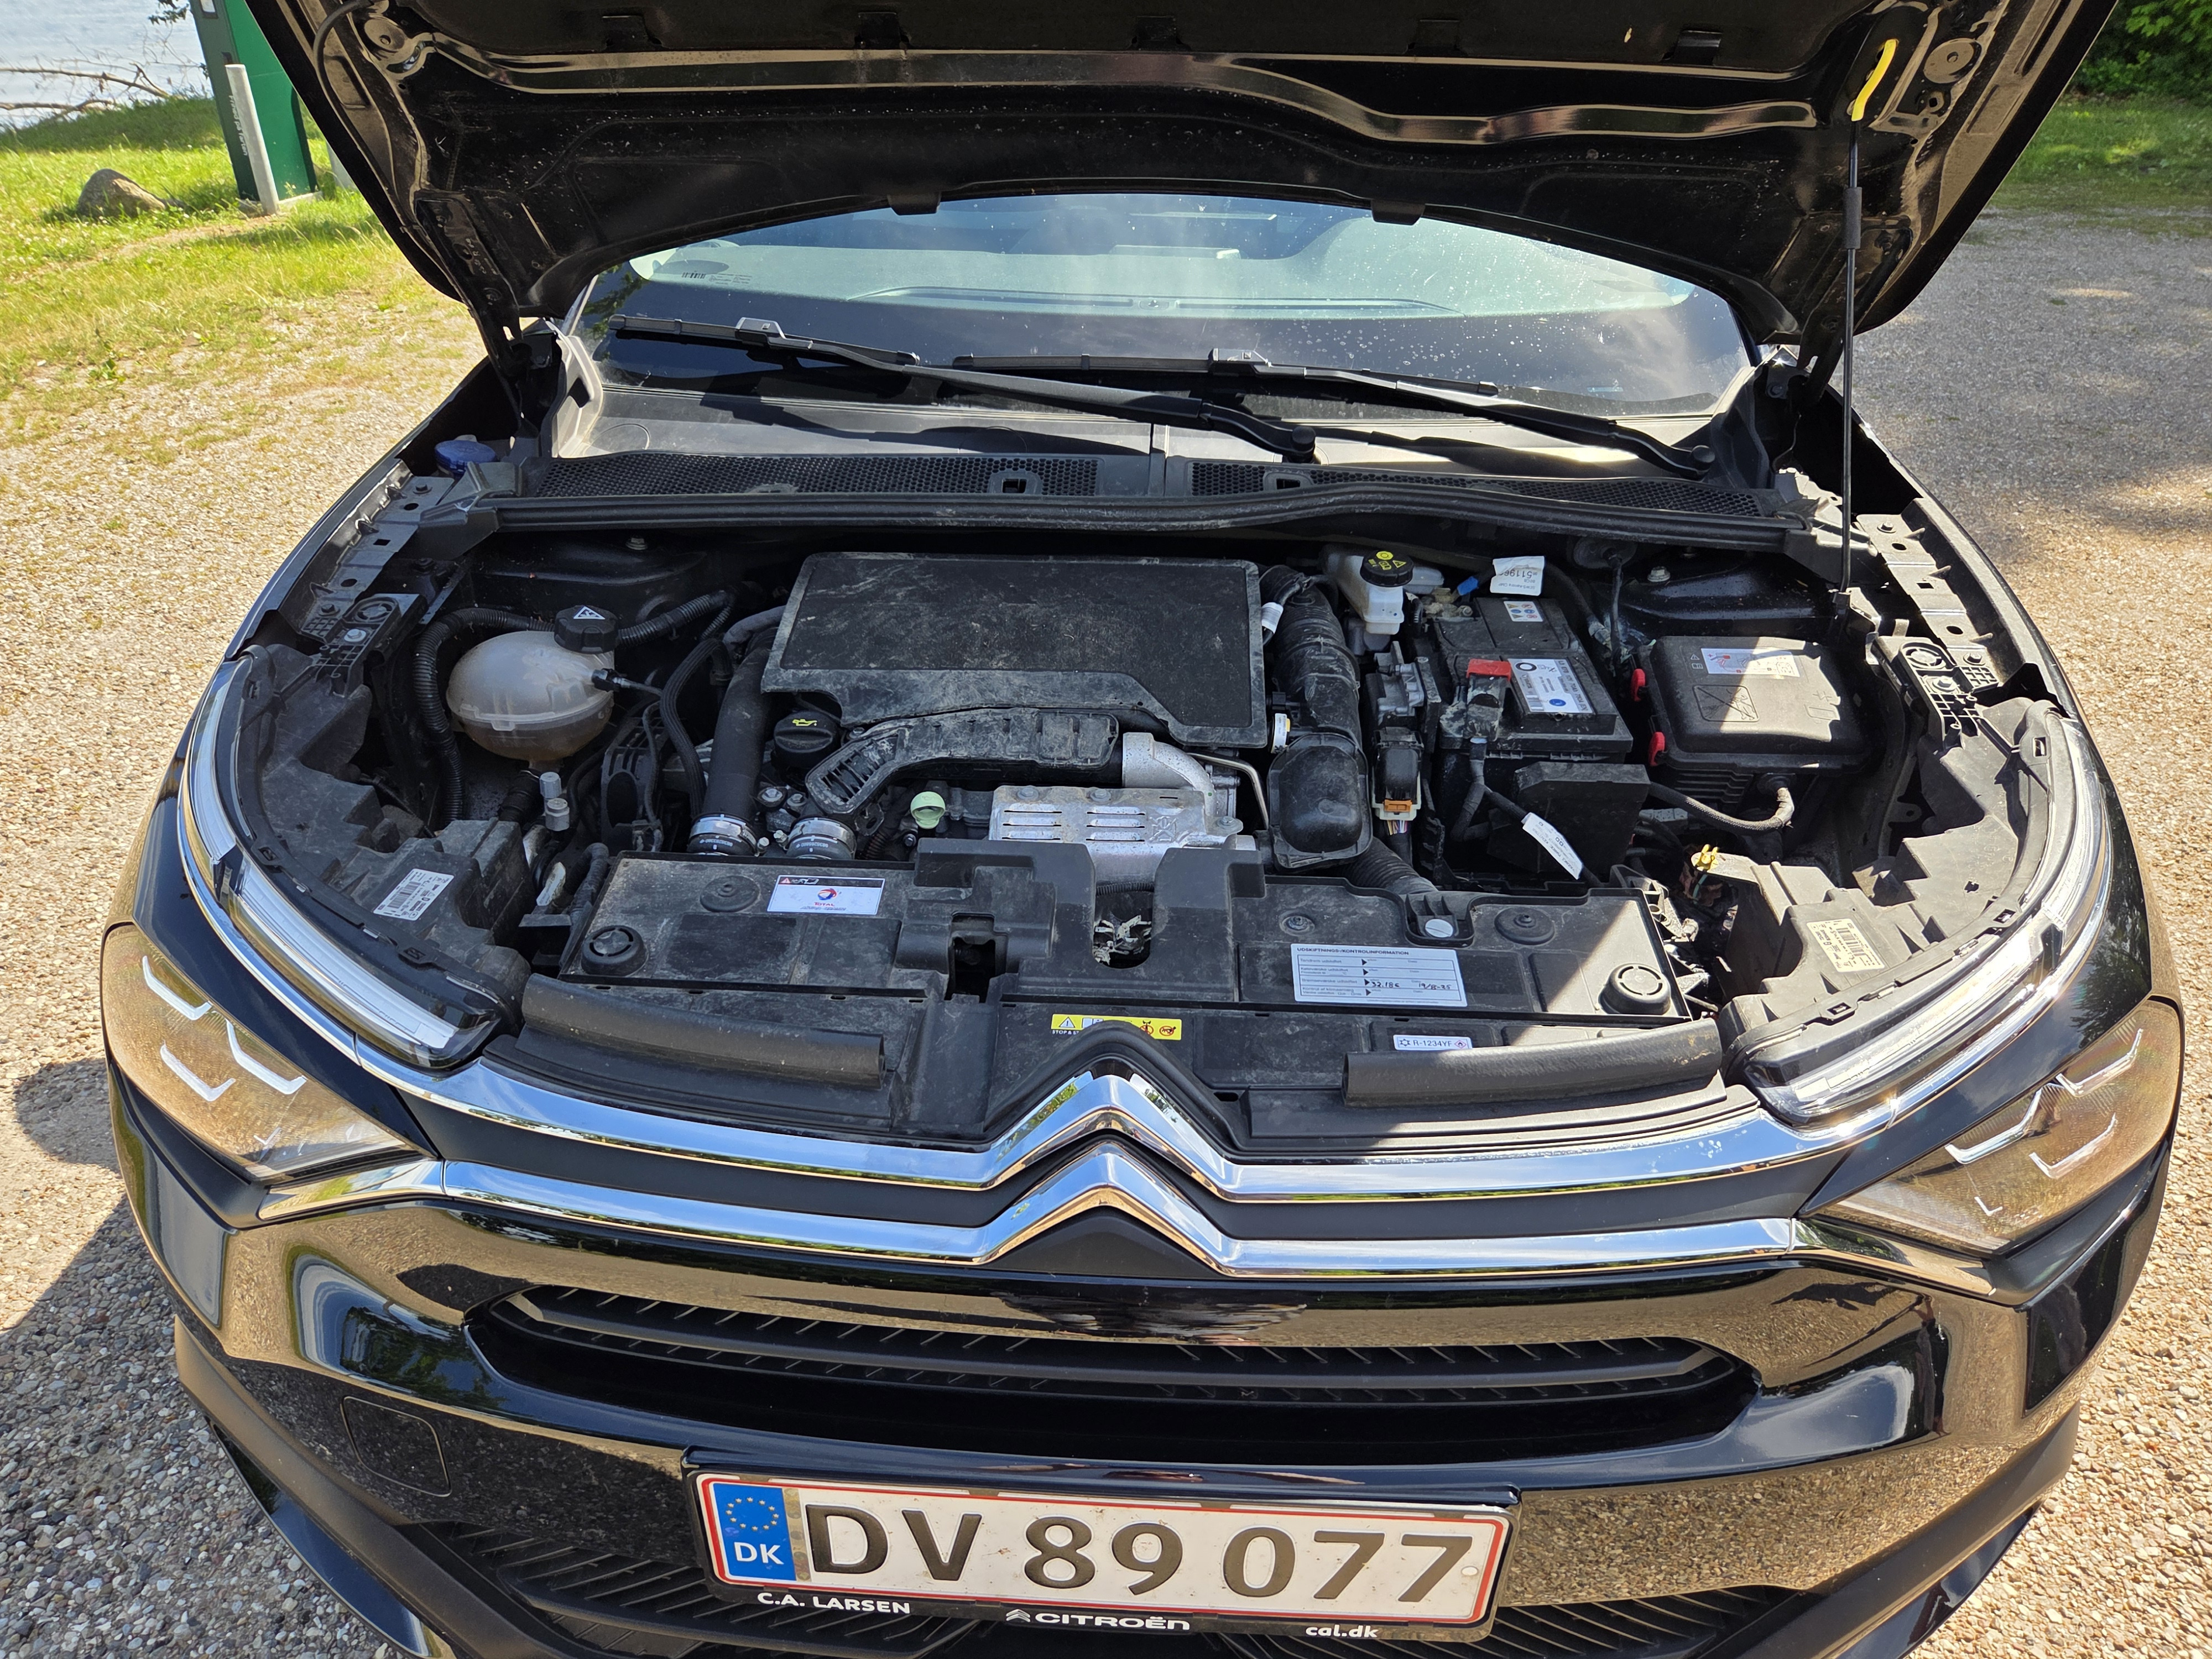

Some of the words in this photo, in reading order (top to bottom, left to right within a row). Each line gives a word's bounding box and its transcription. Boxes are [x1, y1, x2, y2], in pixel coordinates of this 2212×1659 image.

[1498, 569, 1532, 579] 51196
[734, 1541, 784, 1565] DK
[805, 1504, 983, 1581] DV
[1024, 1516, 1183, 1596] 89
[1222, 1526, 1473, 1603] 077
[757, 1592, 805, 1607] C.A.
[812, 1595, 910, 1614] LARSEN
[1305, 1624, 1379, 1639] cal.dk
